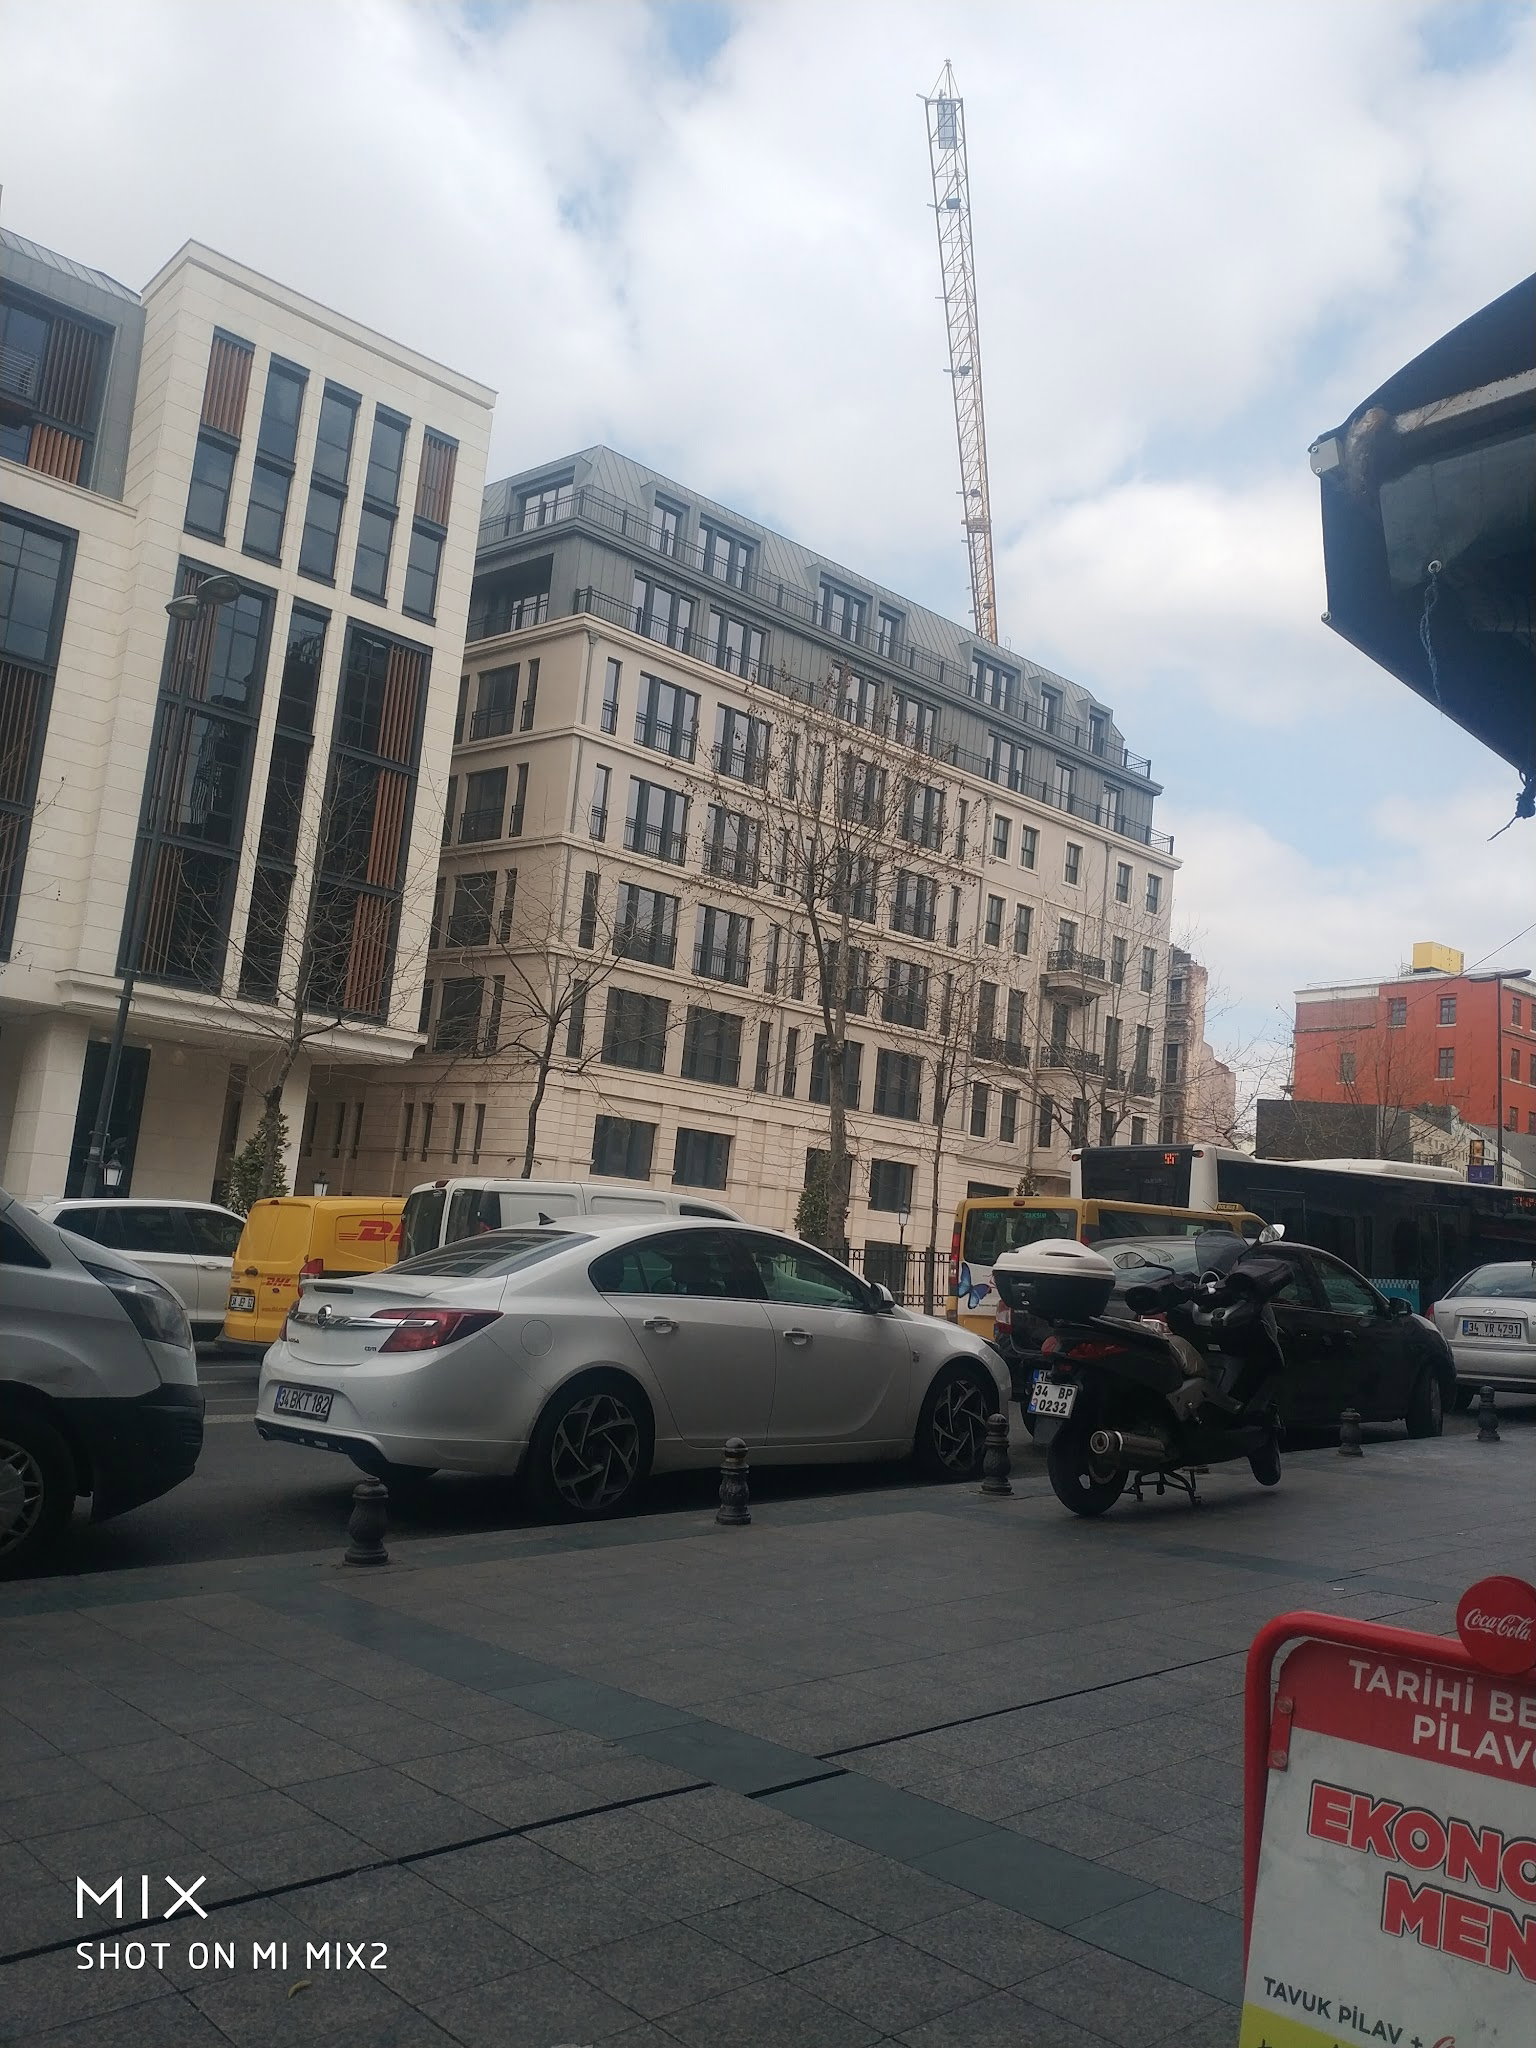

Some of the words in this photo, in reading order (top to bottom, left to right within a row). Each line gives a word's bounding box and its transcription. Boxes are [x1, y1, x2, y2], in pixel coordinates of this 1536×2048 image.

[266, 1277, 292, 1287] DHL
[1469, 1322, 1479, 1332] 34
[1484, 1323, 1495, 1333] YR
[1497, 1324, 1518, 1335] 4791
[279, 1390, 290, 1407] 34
[289, 1391, 312, 1410] BKT
[311, 1393, 330, 1414] 182
[1035, 1384, 1048, 1397] 34
[1058, 1387, 1073, 1399] BP
[1039, 1399, 1067, 1414] 0232
[1349, 1659, 1474, 1714] TARİHİ
[1489, 1689, 1536, 1730] BE
[1412, 1712, 1536, 1770] PİLAV
[1381, 1871, 1536, 1984] MEN
[1263, 1976, 1332, 2019] TAVUK
[1338, 2004, 1403, 2046] PİLAV
